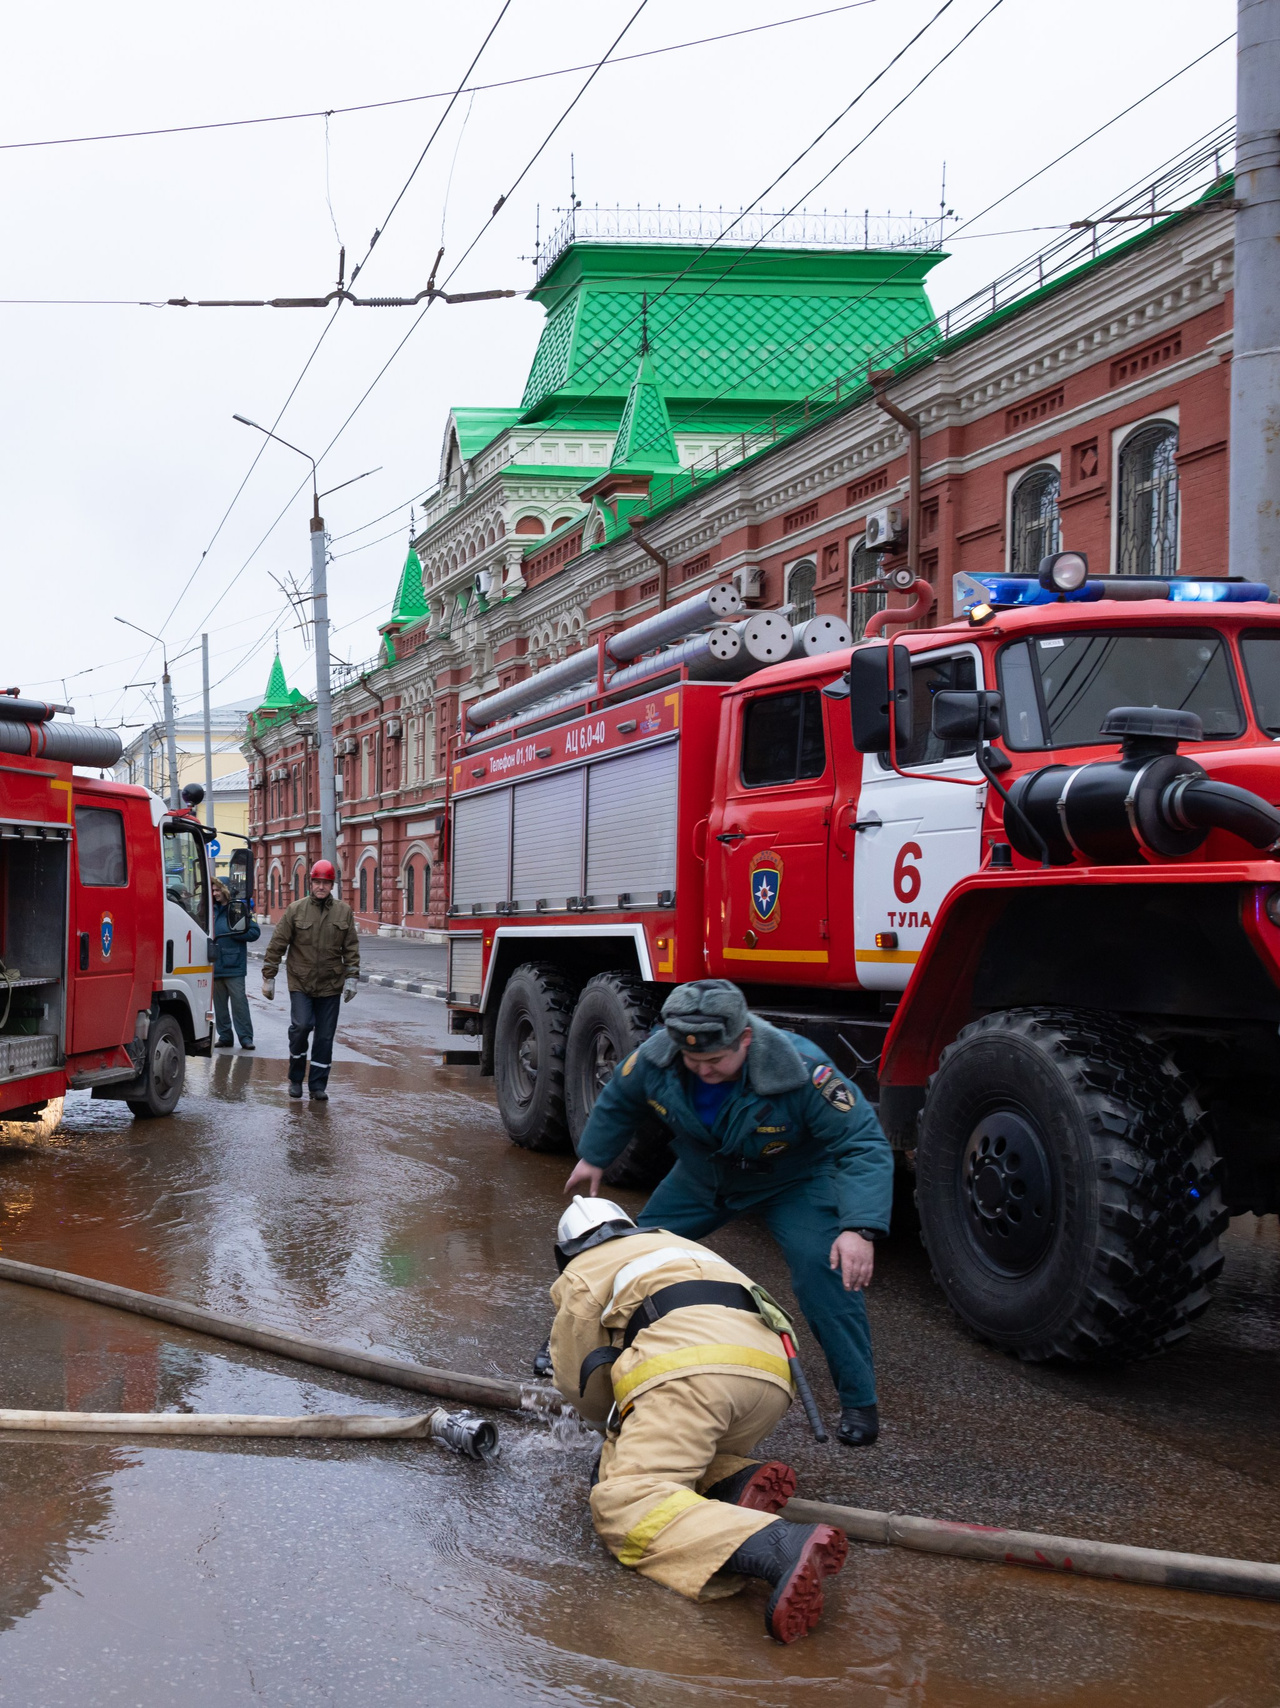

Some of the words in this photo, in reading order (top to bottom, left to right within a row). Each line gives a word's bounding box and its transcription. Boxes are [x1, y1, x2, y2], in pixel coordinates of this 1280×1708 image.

[565, 729, 578, 754] АЦ
[580, 720, 605, 752] 6,0-40
[490, 752, 515, 773] Телефон
[516, 743, 536, 766] 01,101
[893, 841, 923, 904] 6
[887, 911, 933, 928] ТУЛА
[186, 930, 192, 964] 1
